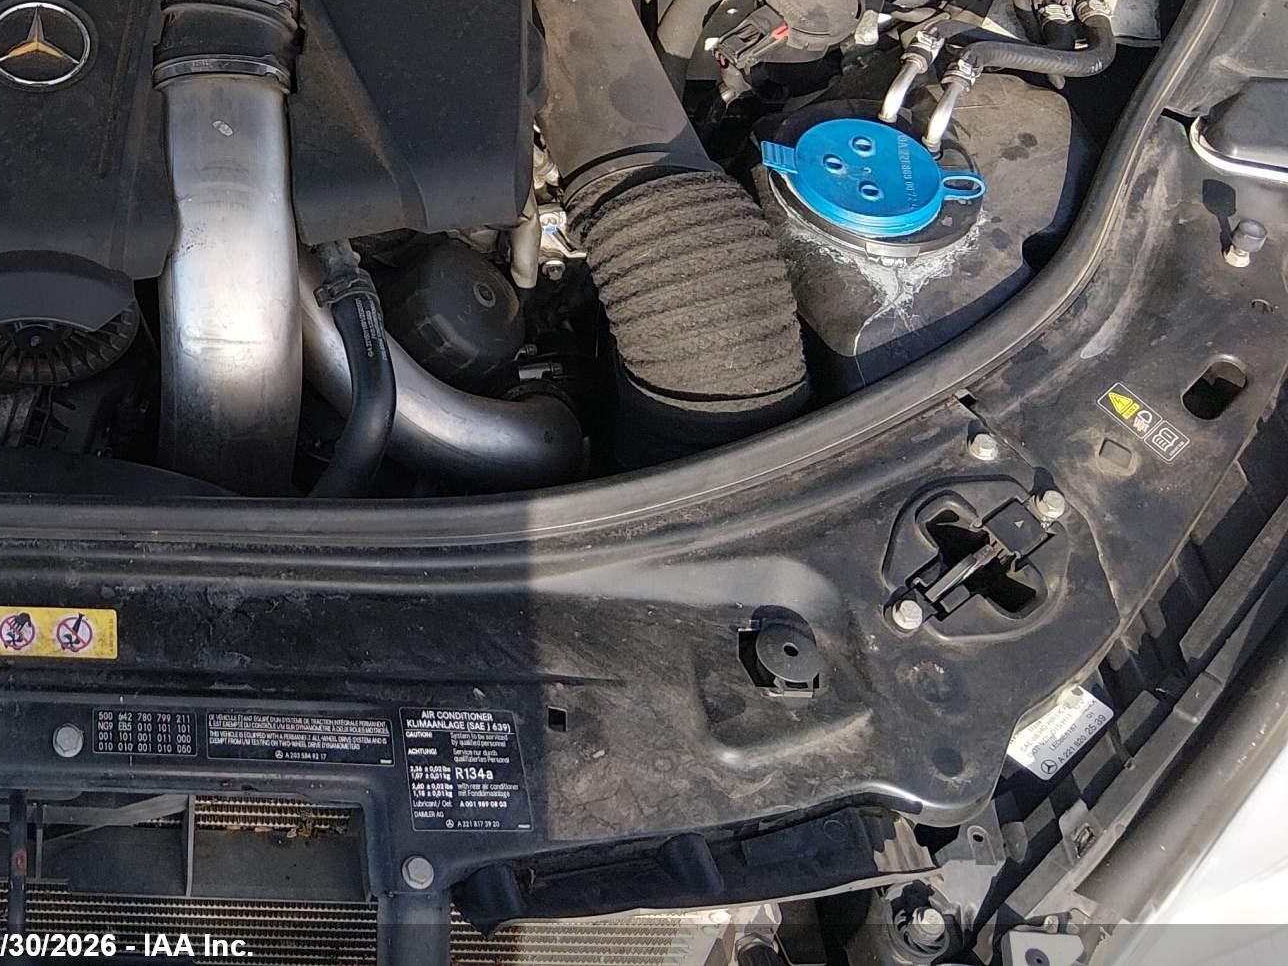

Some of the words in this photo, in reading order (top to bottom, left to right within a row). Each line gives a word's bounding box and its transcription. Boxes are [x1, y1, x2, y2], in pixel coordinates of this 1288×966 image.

[98, 711, 112, 720] 500
[118, 712, 132, 720] 642
[137, 713, 152, 722] 780
[156, 714, 171, 722] 799
[176, 714, 190, 722] 211
[422, 710, 435, 719] AIR
[438, 712, 494, 721] CONDITIONER
[1094, 713, 1106, 725] 39
[137, 723, 152, 732] 010
[158, 724, 171, 732] 101
[178, 724, 190, 732] 101
[406, 719, 465, 730] KLIMAANLAGE
[467, 722, 486, 732] (SAE
[492, 723, 511, 733] 639)
[98, 732, 112, 740] 001
[119, 732, 132, 740] 101
[137, 733, 152, 741] 001
[157, 734, 171, 742] 011
[176, 734, 191, 743] 000
[98, 742, 112, 750] 010
[118, 742, 132, 751] 010
[137, 743, 152, 751] 001
[158, 744, 172, 752] 010
[455, 767, 494, 780] R134a
